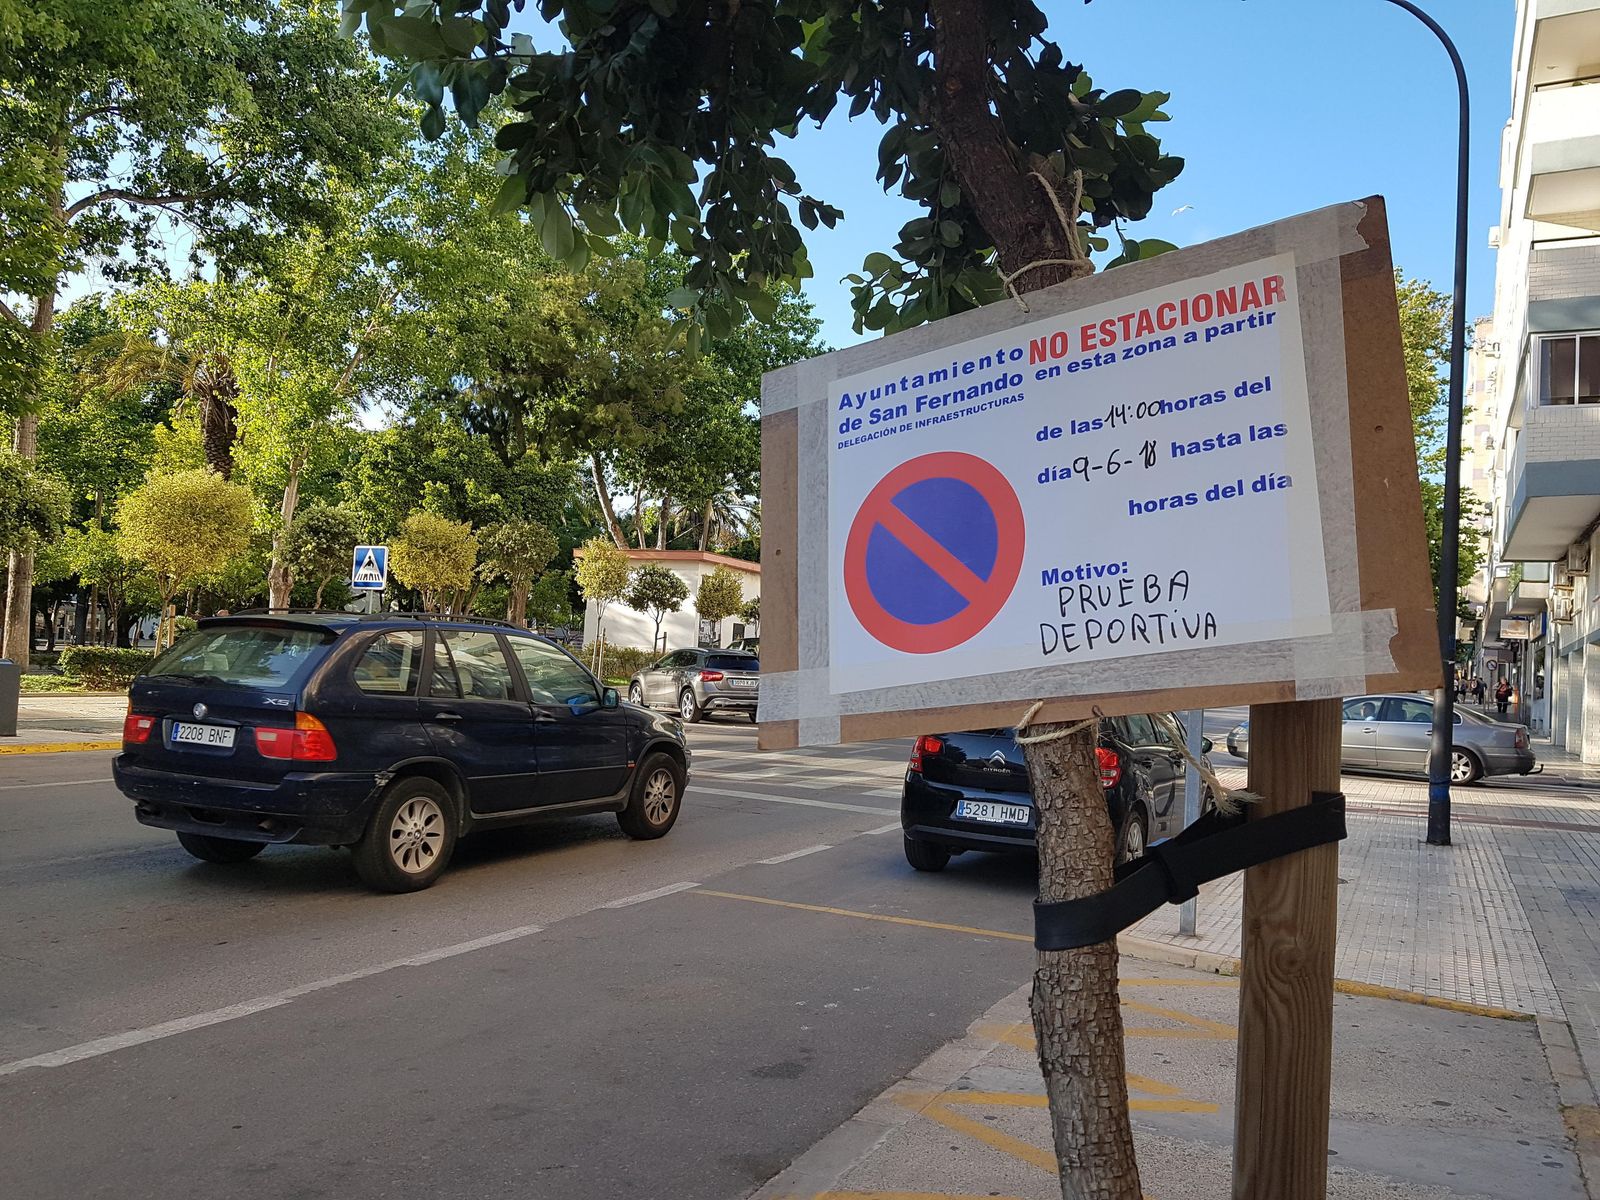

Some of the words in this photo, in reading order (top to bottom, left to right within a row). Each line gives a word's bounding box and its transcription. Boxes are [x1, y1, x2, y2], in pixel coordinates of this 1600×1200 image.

[1029, 331, 1068, 365] NO
[1080, 274, 1287, 353] ESTACIONAR
[1035, 365, 1061, 381] en
[1067, 350, 1117, 373] esta
[1122, 335, 1177, 361] zona
[1183, 329, 1198, 344] a
[1205, 310, 1276, 342] partir
[838, 347, 1024, 410] Ayuntamiento
[838, 417, 863, 435] de
[869, 403, 908, 425] San
[915, 372, 1024, 414] Fernando
[1036, 425, 1063, 442] de
[1070, 417, 1104, 435] las
[1104, 400, 1162, 428] 14:00
[1160, 389, 1226, 415] horas
[1233, 375, 1272, 399] del
[838, 426, 897, 450] DELEGACIÓN
[899, 422, 913, 433] DE
[915, 392, 1025, 429] INFRAESTRUCTURAS
[1037, 466, 1072, 485] día
[1171, 432, 1242, 458] hasta
[1249, 422, 1289, 442] las
[1128, 491, 1198, 516] horas
[1205, 479, 1244, 502] del
[1251, 472, 1292, 494] día
[1041, 561, 1129, 586] Motivo:
[1058, 569, 1189, 618] PRUEBA
[178, 723, 204, 741] 2208
[208, 728, 230, 744] BNF
[965, 802, 995, 818] 5281
[1000, 806, 1025, 821] HMD
